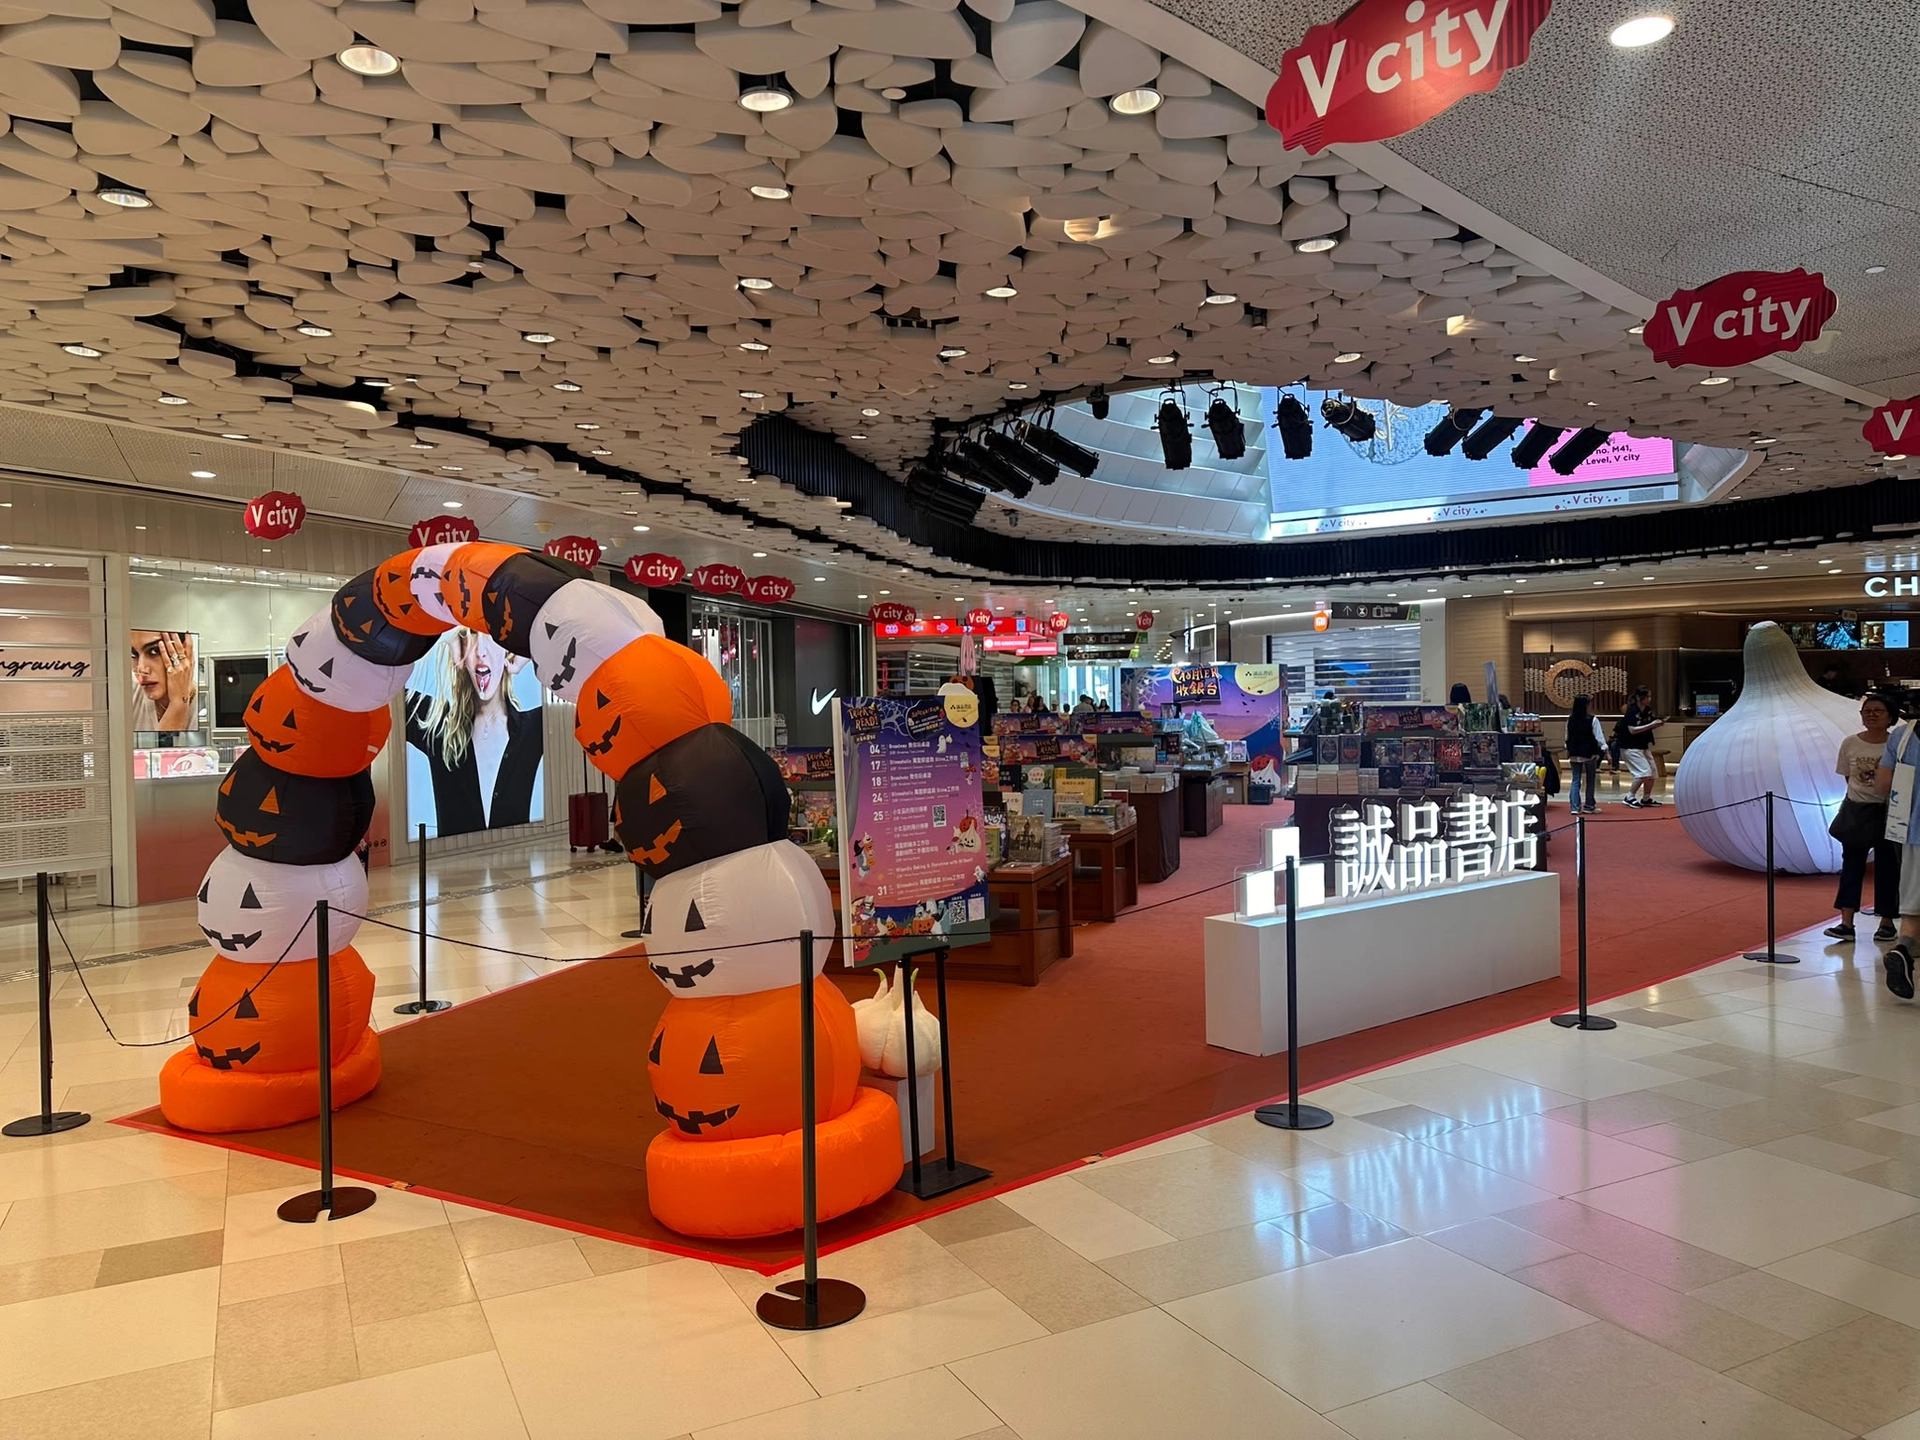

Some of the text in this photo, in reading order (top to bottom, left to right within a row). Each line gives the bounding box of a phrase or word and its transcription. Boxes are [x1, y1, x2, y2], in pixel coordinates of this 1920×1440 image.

[1297, 0, 1508, 118] V city
[1667, 288, 1811, 346] V city
[1882, 409, 1913, 441] V
[1586, 457, 1612, 465] Level,
[1624, 454, 1640, 462] city
[1573, 494, 1603, 504] V city
[251, 500, 298, 528] V city
[1443, 506, 1471, 516] V city
[1338, 518, 1356, 527] city
[416, 523, 470, 547] V city
[548, 542, 594, 565] V city
[631, 559, 678, 580] V city
[698, 570, 739, 588] V city
[746, 581, 788, 598] V city
[1865, 576, 1918, 597] CH
[873, 606, 902, 620] V city
[969, 612, 990, 624] V city
[1050, 616, 1067, 628] V city
[0, 649, 90, 677] ngraving
[1171, 666, 1221, 683] CASHIER
[1176, 681, 1217, 696] 收銀台
[856, 716, 878, 730] READ!
[870, 744, 880, 754] 04
[871, 761, 880, 770] 17
[872, 777, 882, 786] 18
[872, 794, 882, 802] 24
[874, 811, 884, 820] 25
[1332, 788, 1540, 898] 誠品書店
[878, 886, 887, 896] 31
